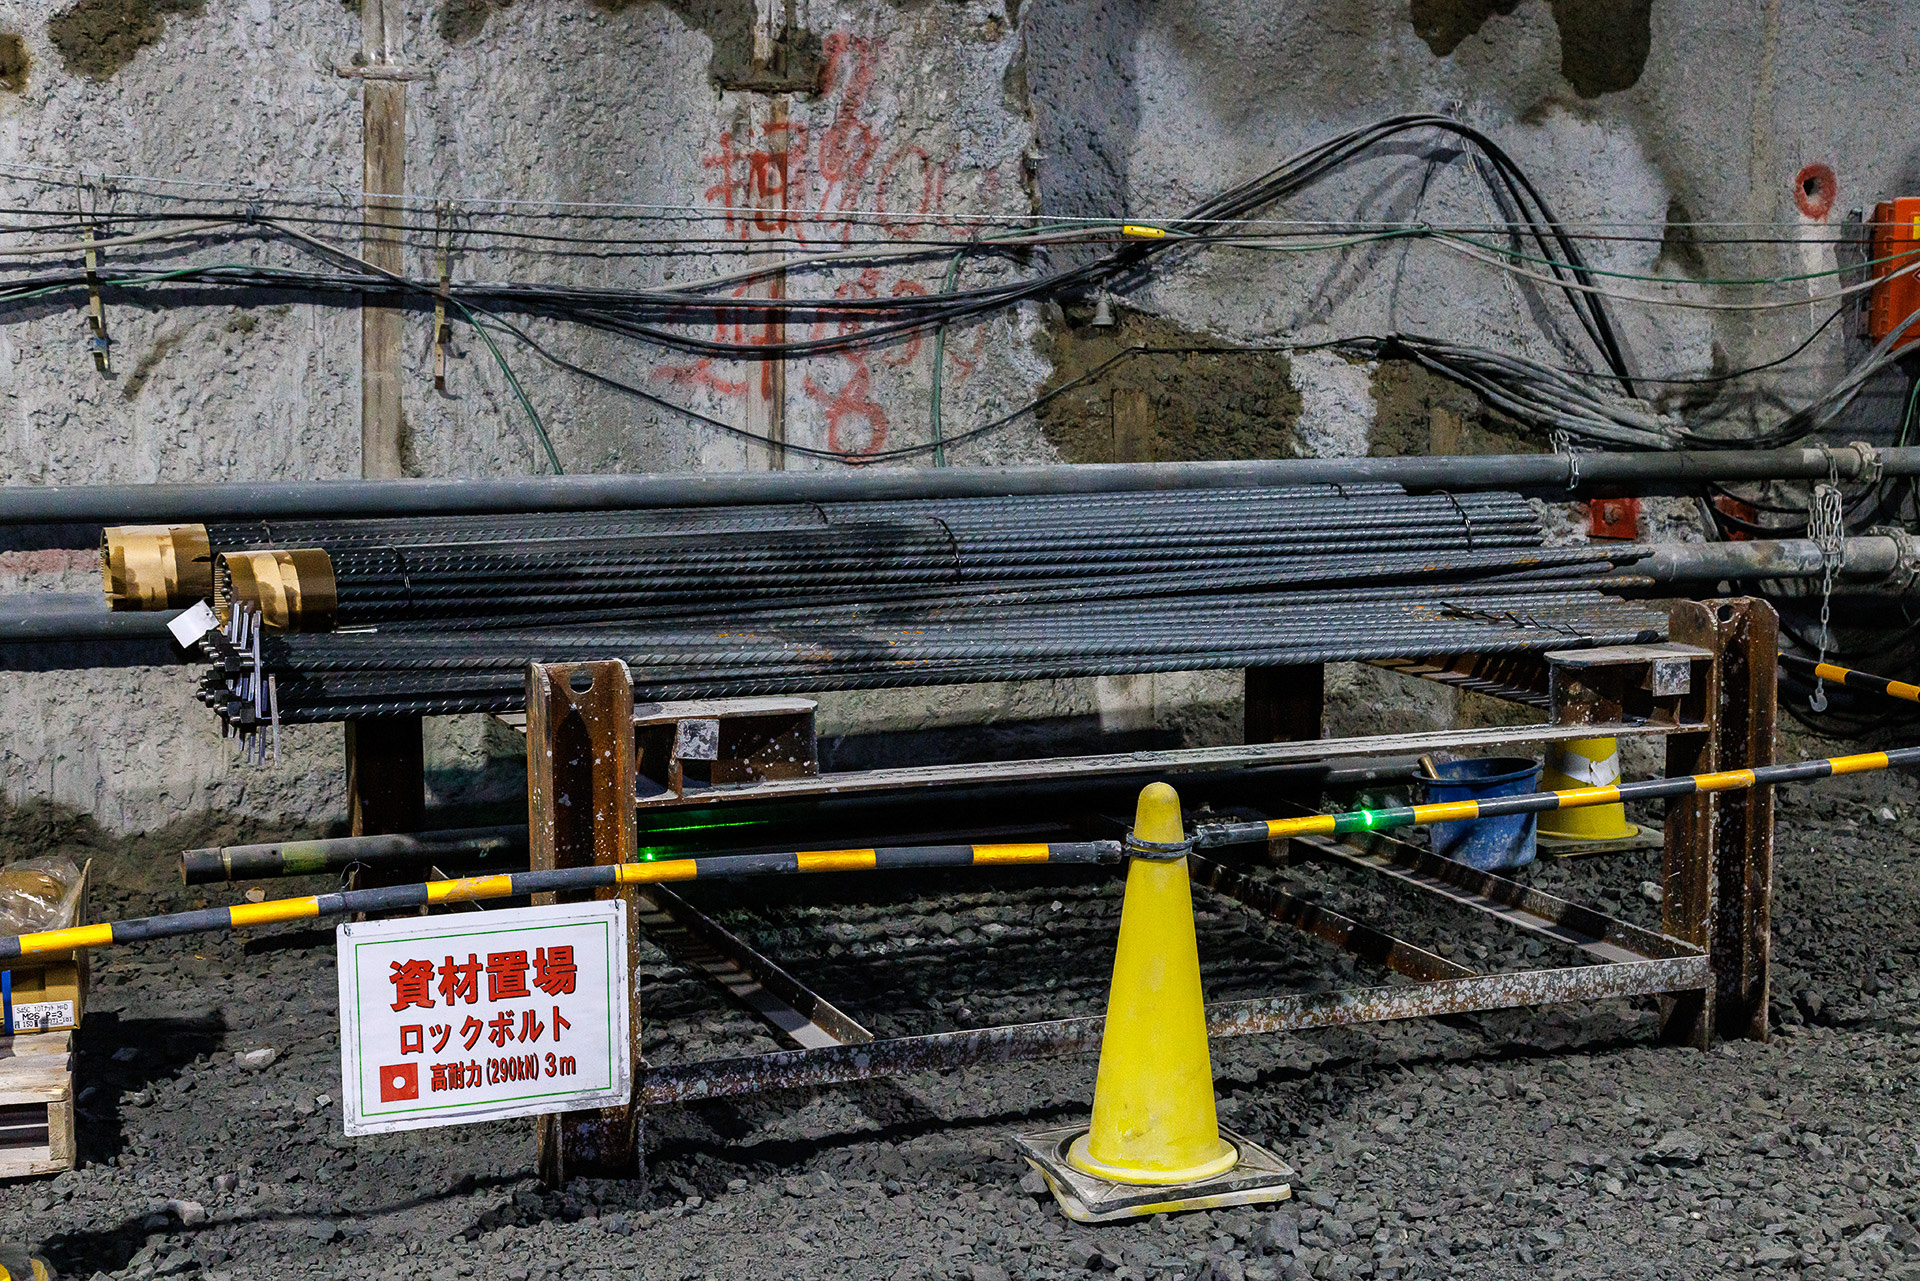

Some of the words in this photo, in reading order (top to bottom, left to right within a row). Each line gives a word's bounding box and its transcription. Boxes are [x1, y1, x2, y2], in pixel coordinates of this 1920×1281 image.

[389, 945, 577, 1012] 資材置場
[22, 1012, 40, 1020] M26
[400, 1006, 571, 1055] ロックボルト
